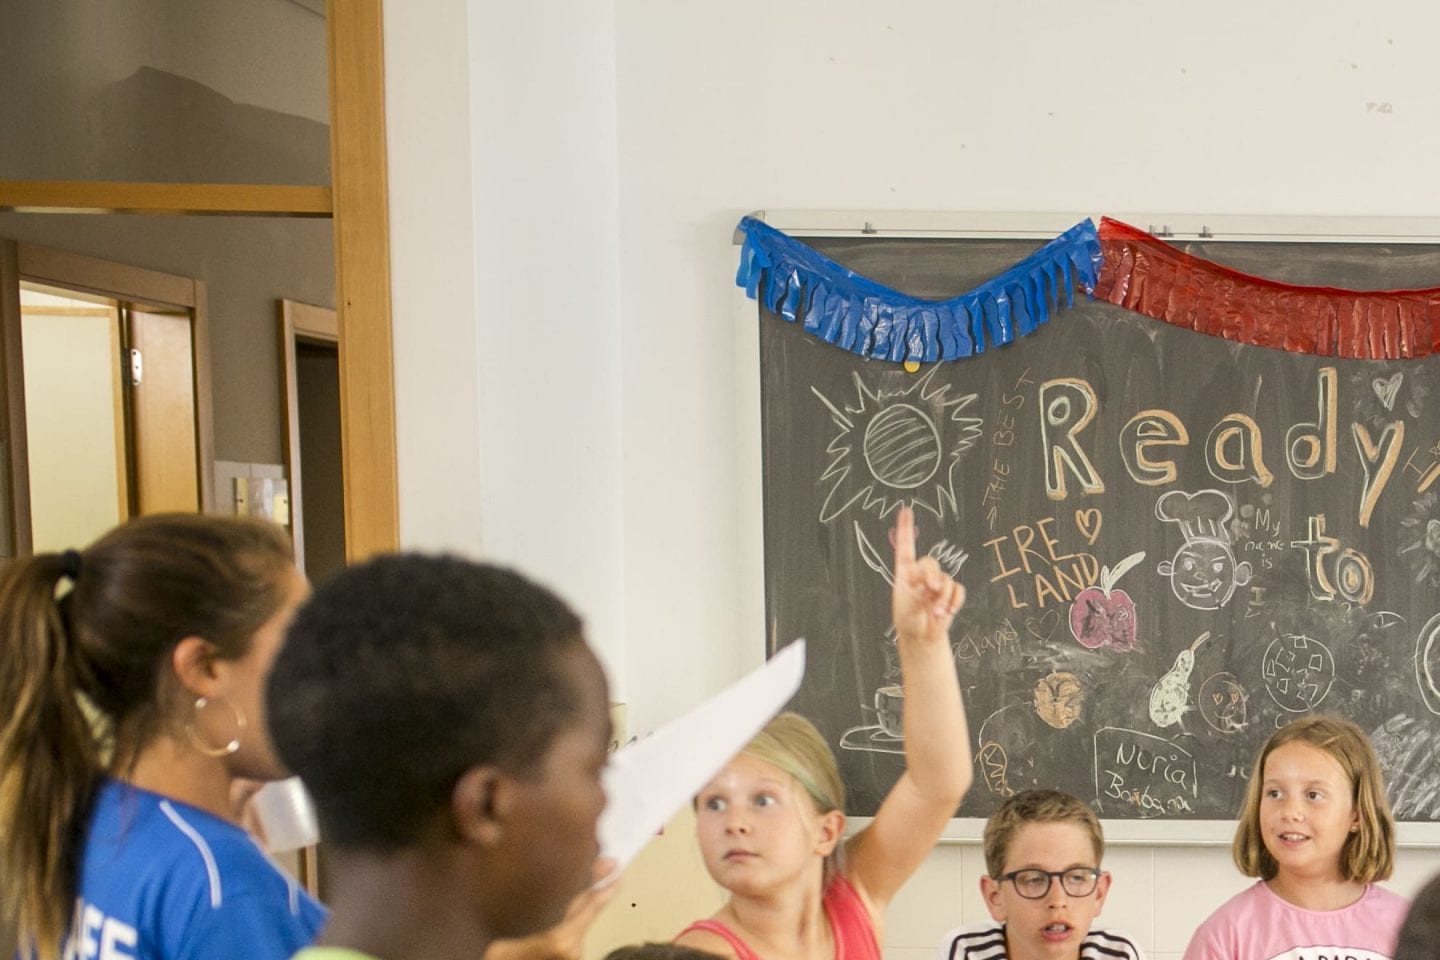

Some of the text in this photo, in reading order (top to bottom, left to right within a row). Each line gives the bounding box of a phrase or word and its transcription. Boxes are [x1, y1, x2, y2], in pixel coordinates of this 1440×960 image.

[992, 366, 1036, 447] BEST
[1039, 366, 1405, 530] Ready
[983, 516, 1056, 582] IRE
[1255, 507, 1281, 538] My
[1007, 553, 1099, 609] LAND
[1262, 553, 1273, 569] is
[1290, 513, 1375, 605] to
